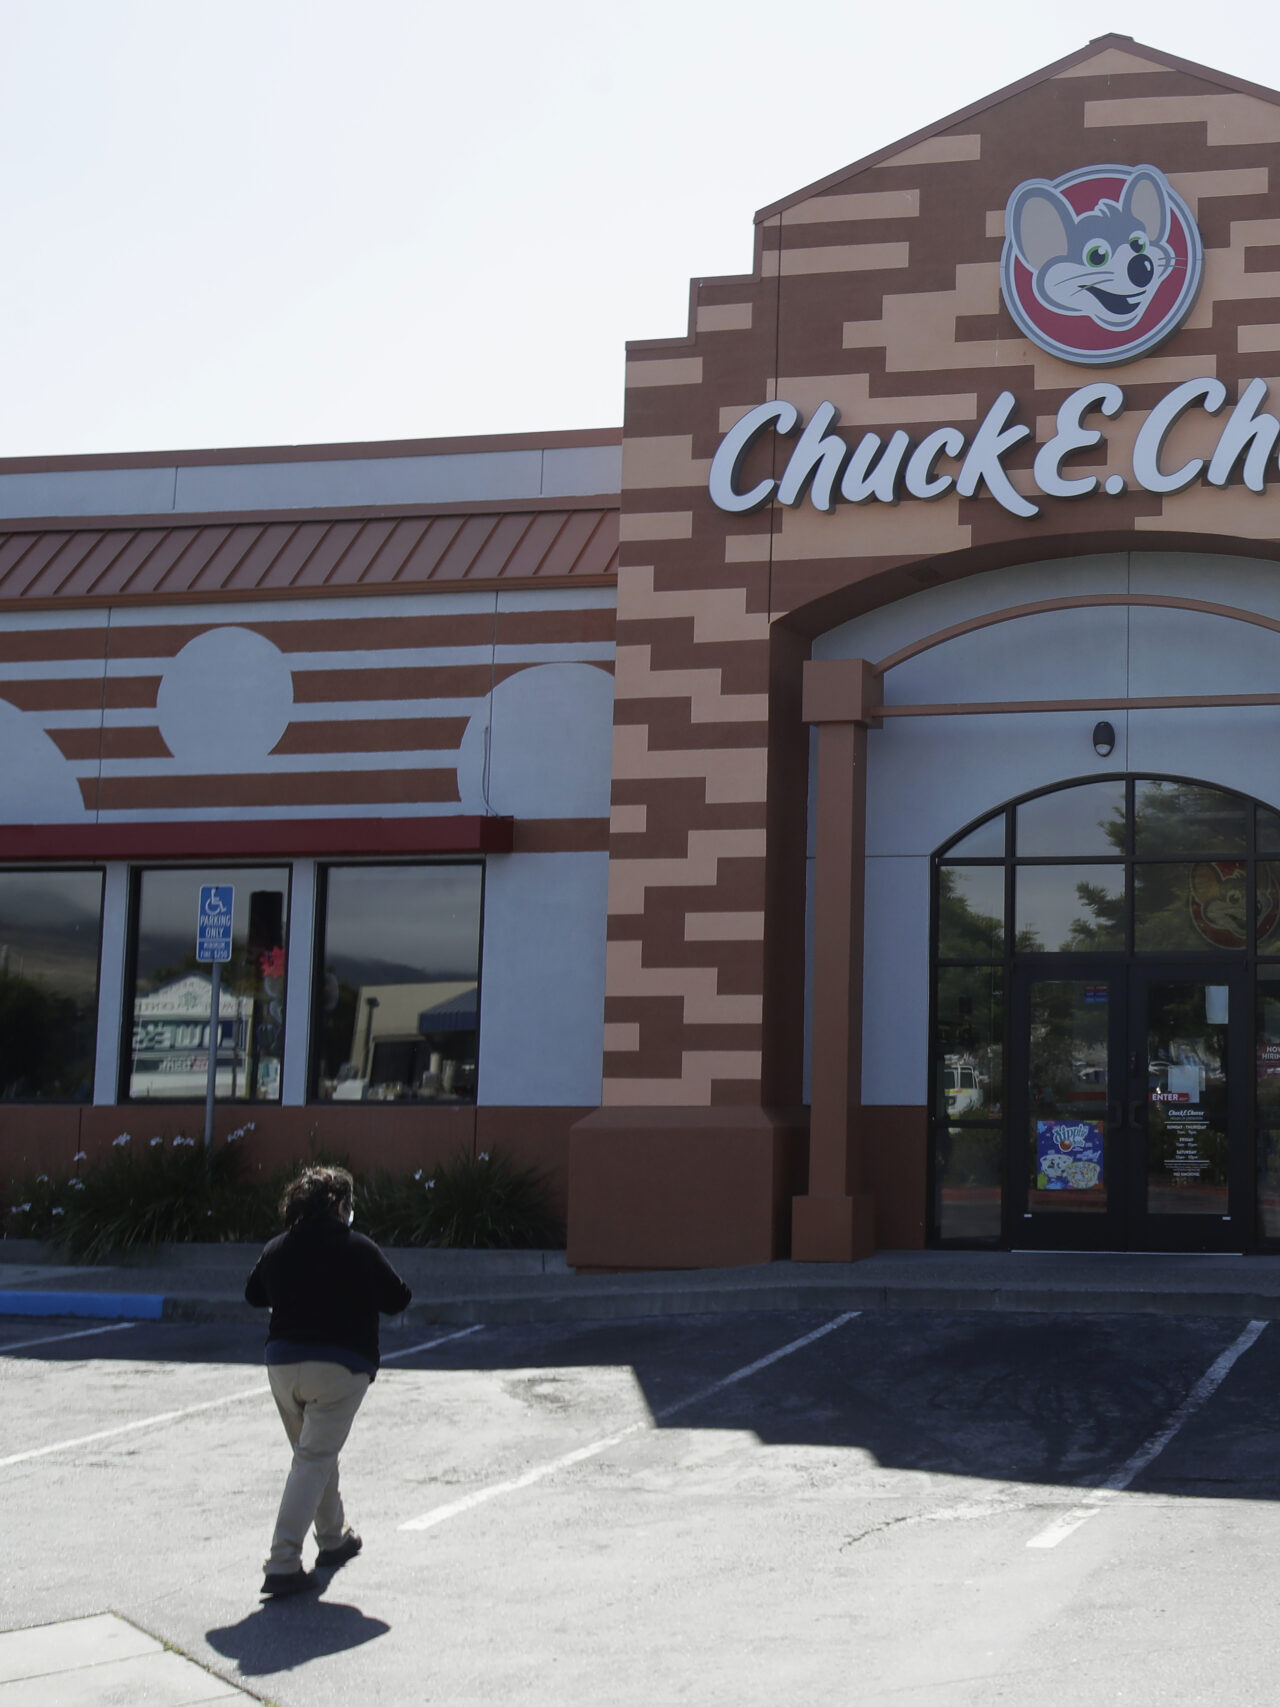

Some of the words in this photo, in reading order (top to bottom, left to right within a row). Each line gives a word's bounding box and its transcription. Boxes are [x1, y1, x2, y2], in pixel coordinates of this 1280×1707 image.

[709, 391, 1042, 518] Chuck
[200, 914, 231, 927] PARKING
[205, 927, 225, 938] ONLY
[1152, 1093, 1179, 1101] ENTER
